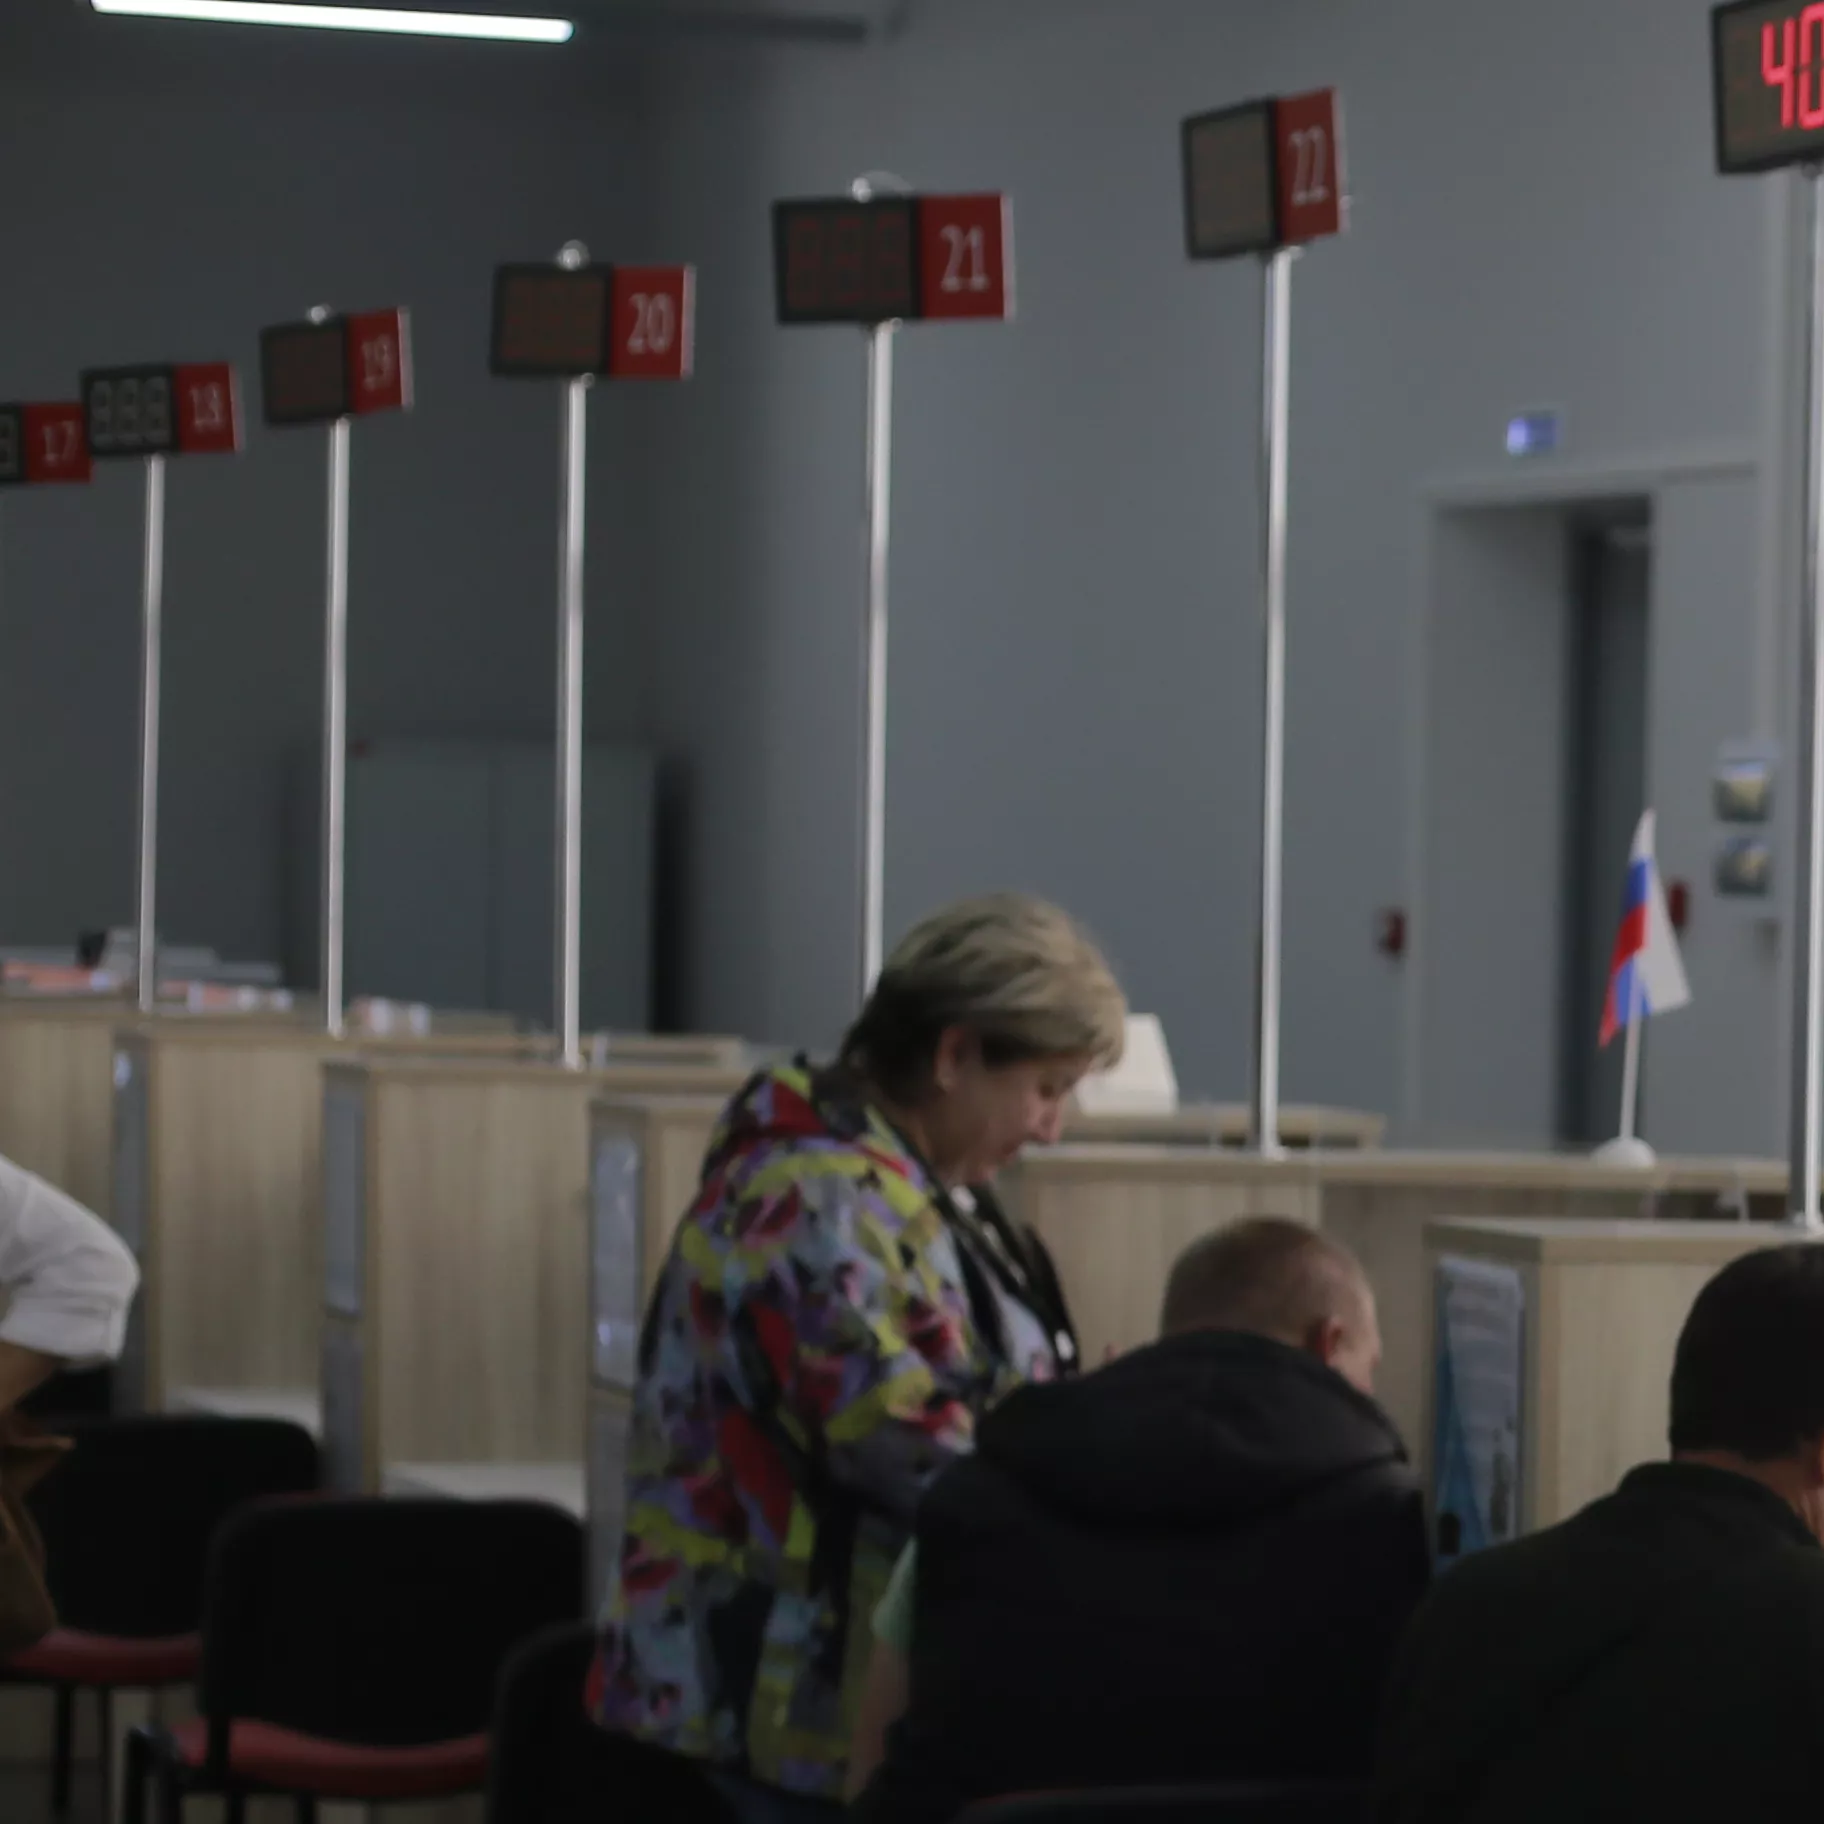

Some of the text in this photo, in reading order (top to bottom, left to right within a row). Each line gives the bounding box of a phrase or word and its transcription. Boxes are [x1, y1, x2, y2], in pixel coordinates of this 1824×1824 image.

[1288, 125, 1328, 206] 22
[939, 224, 990, 293] 21
[627, 292, 675, 355] 20
[360, 334, 393, 391] 19
[189, 382, 222, 431] 18
[42, 420, 76, 465] 17
